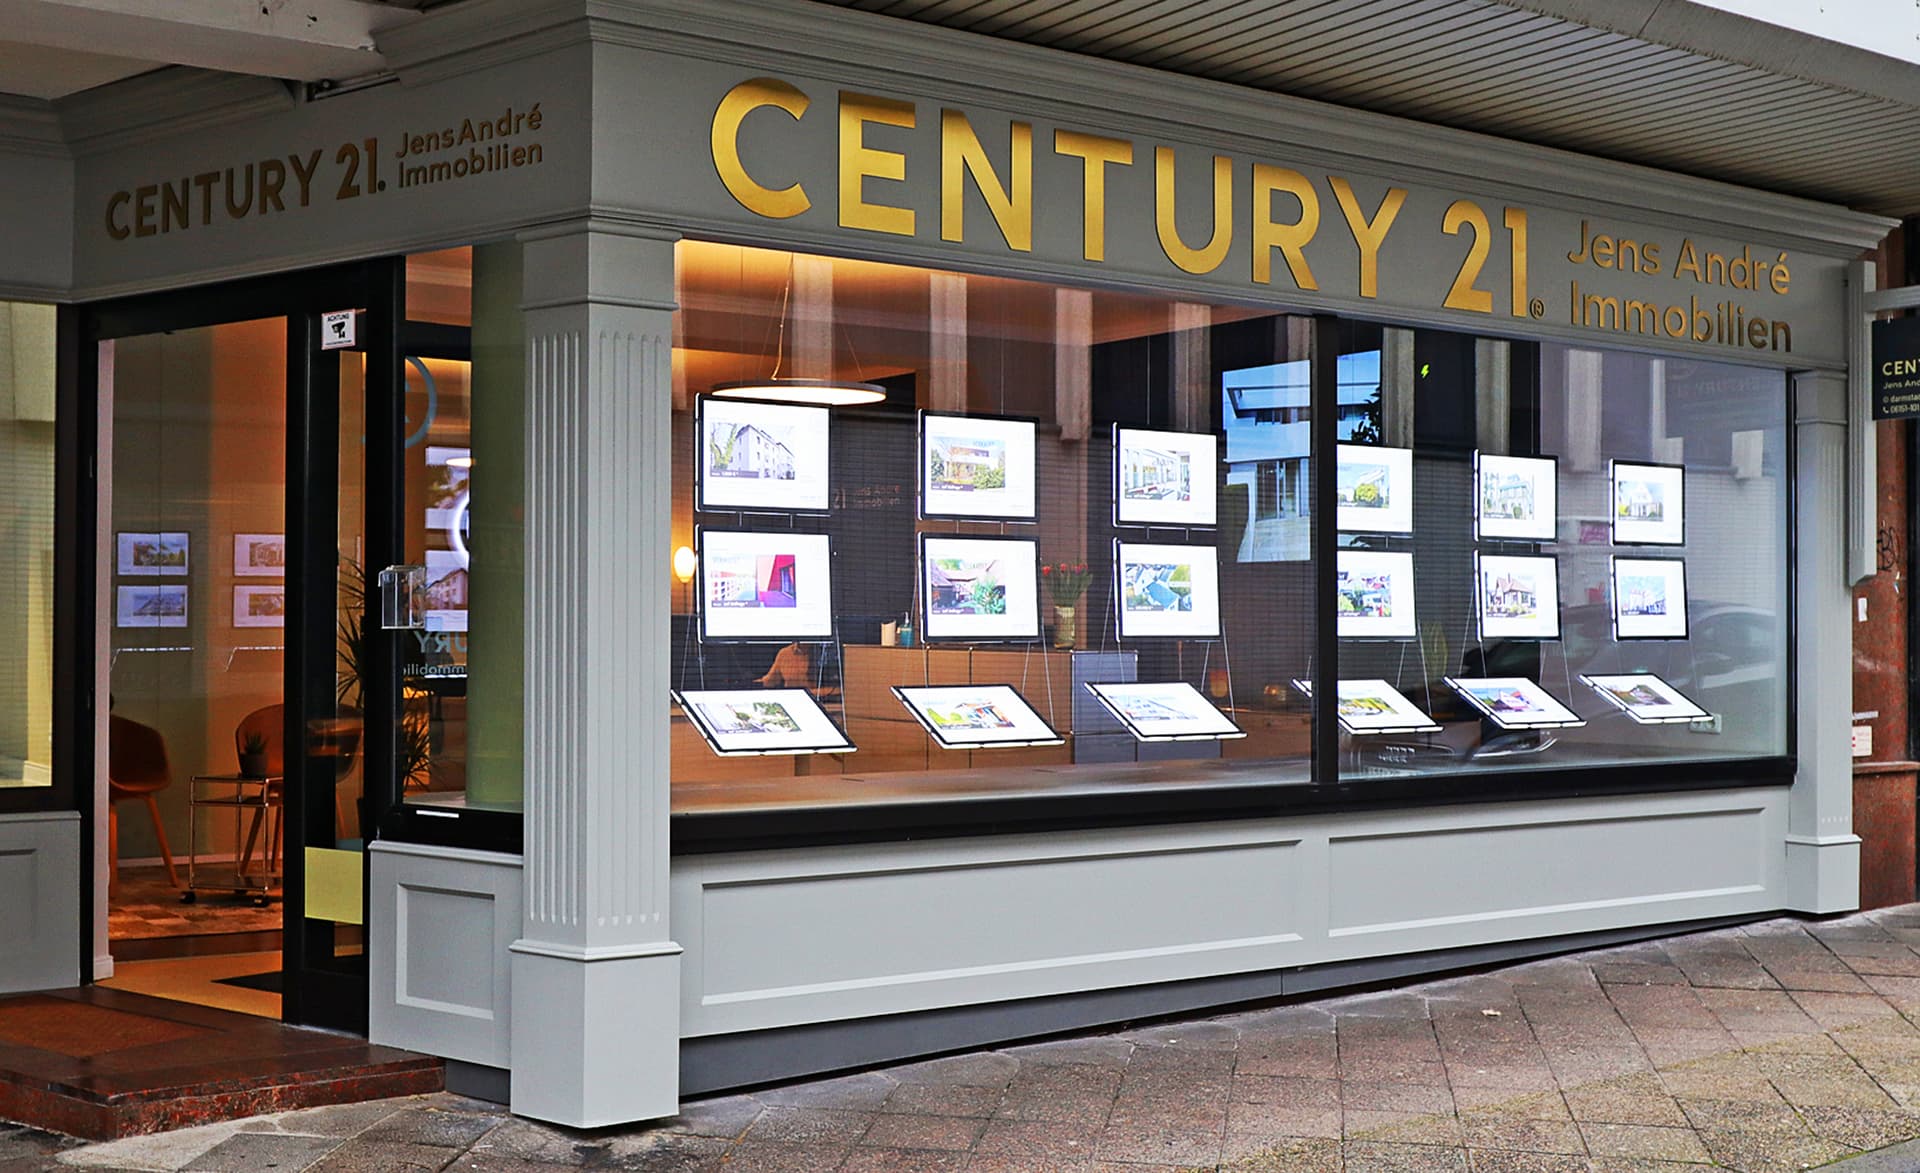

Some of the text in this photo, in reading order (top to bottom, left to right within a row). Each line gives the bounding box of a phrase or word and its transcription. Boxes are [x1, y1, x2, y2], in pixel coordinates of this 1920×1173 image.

[104, 149, 322, 241] CENTURY
[398, 143, 543, 189] Immobilien
[711, 77, 1408, 297] CENTURY
[1567, 220, 1792, 295] Jens André
[1571, 281, 1792, 354] Immobilien
[1882, 358, 1920, 376] CEN
